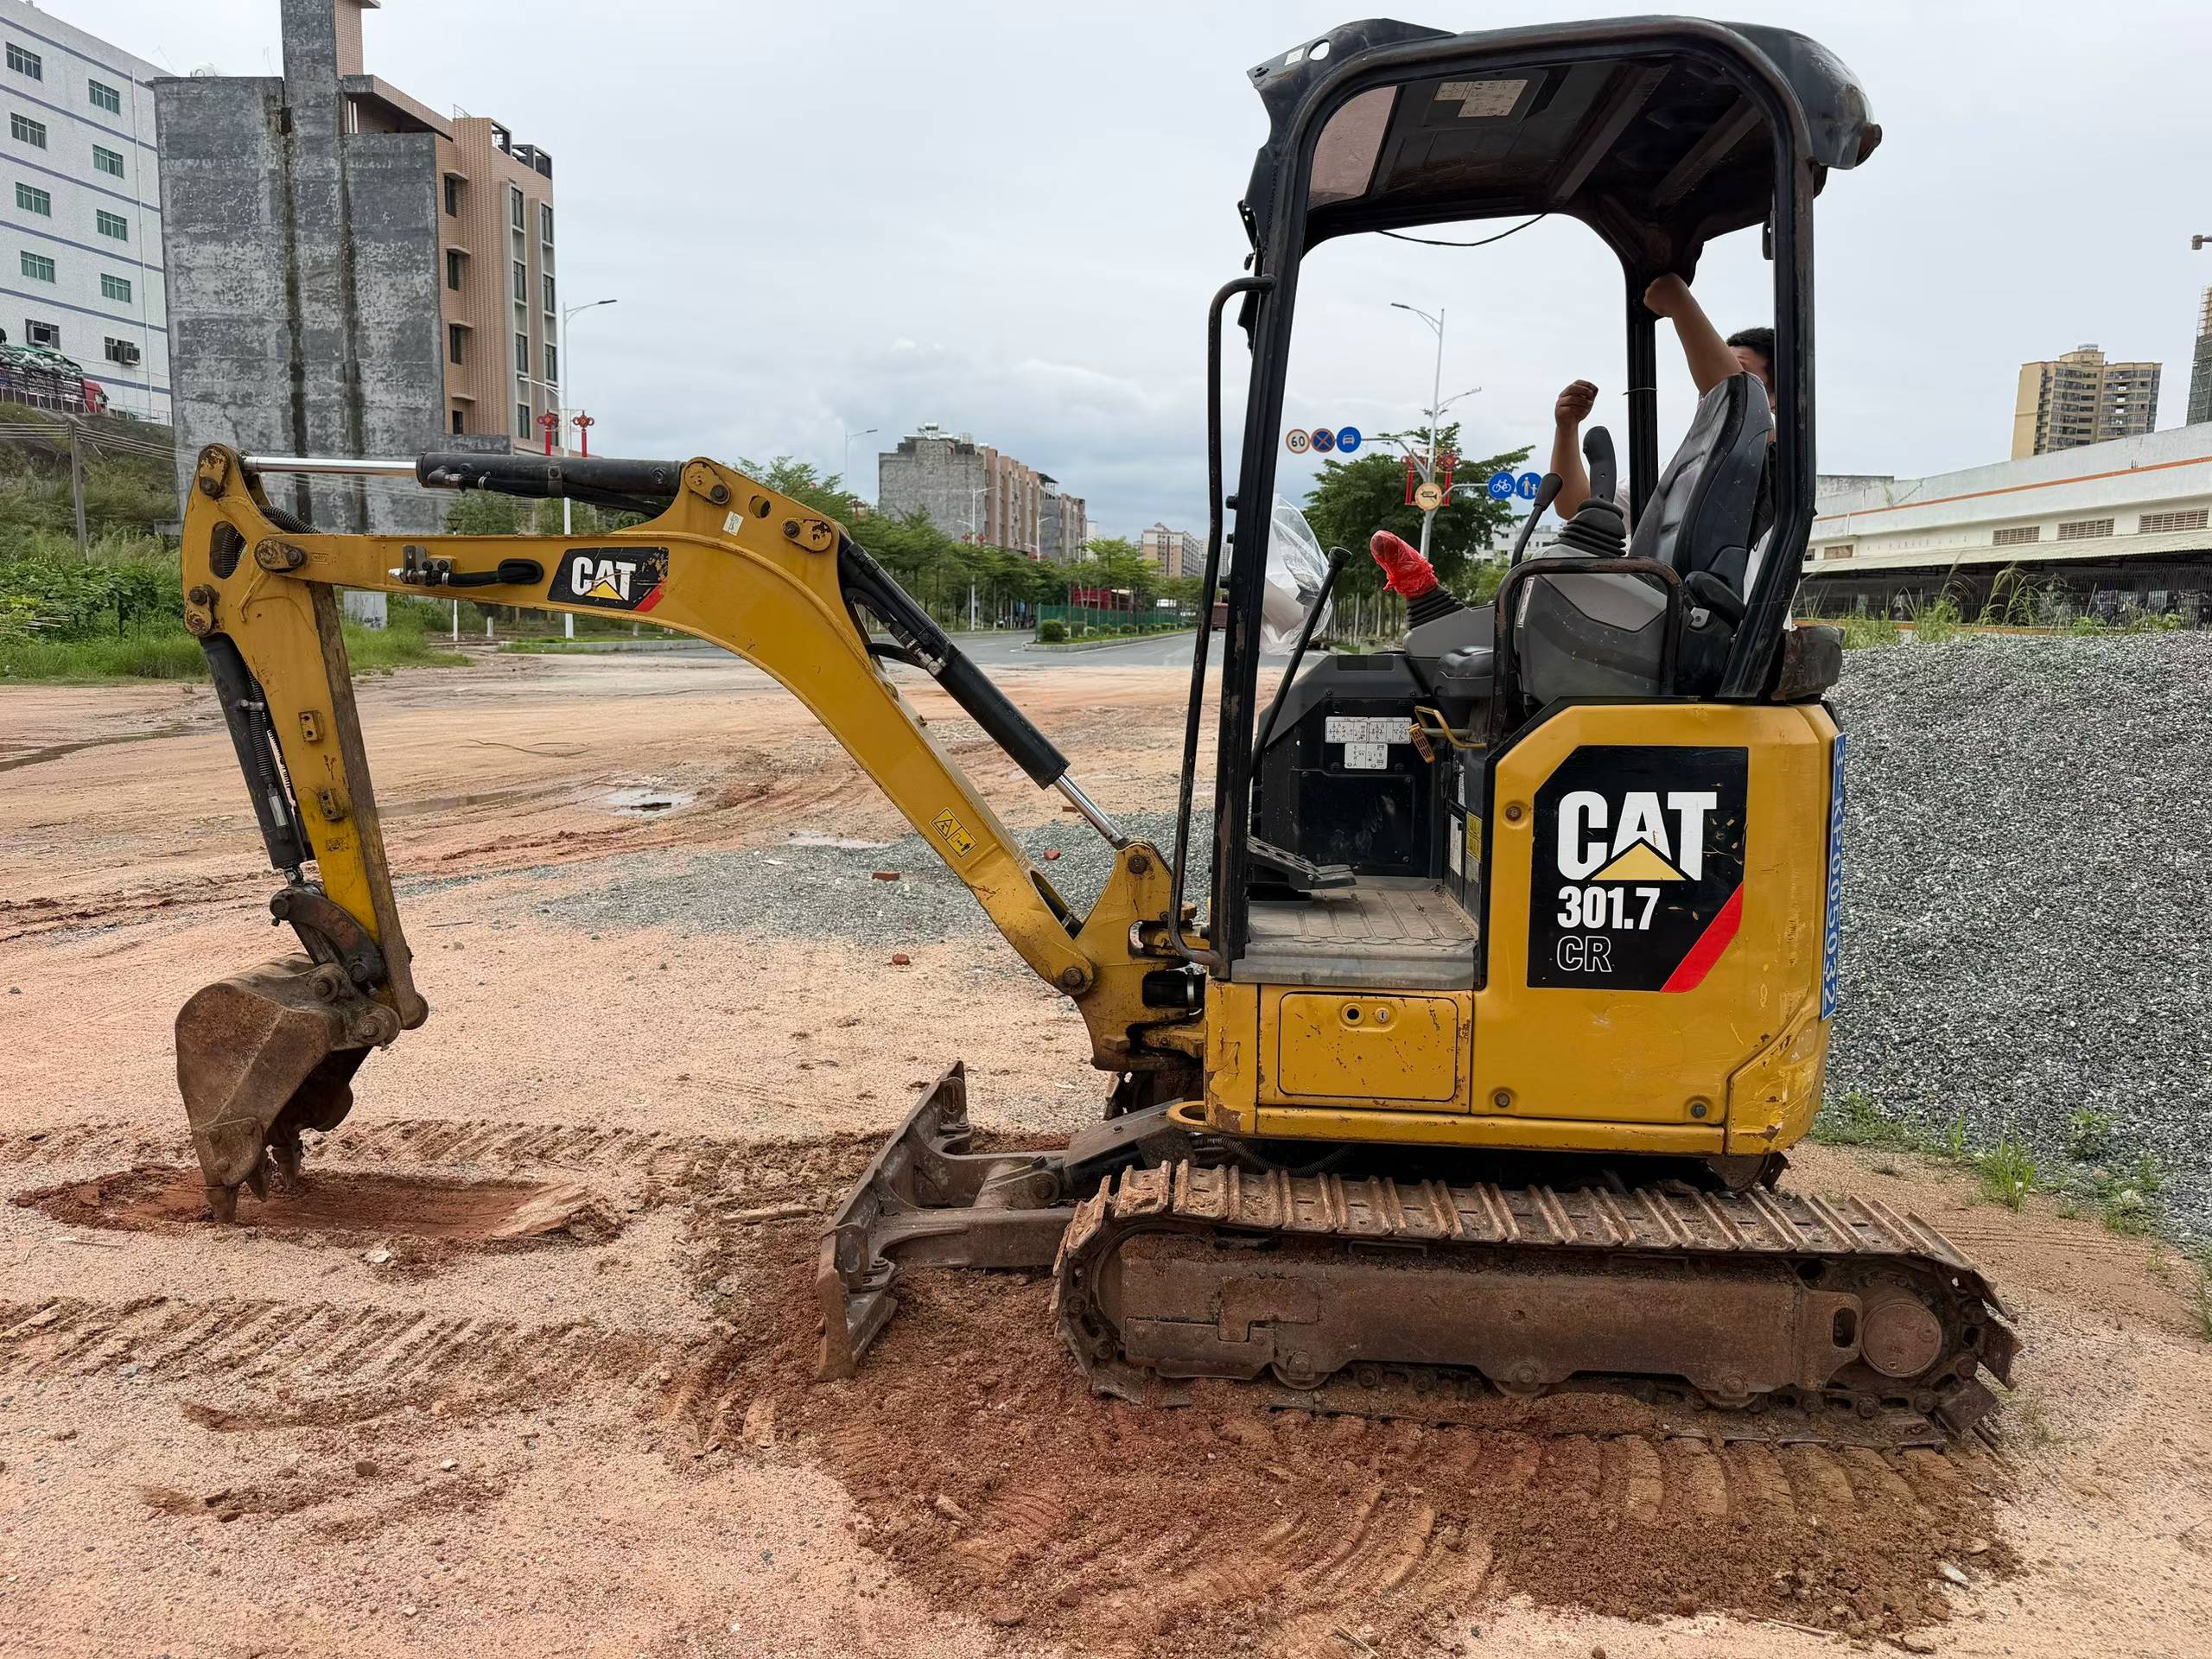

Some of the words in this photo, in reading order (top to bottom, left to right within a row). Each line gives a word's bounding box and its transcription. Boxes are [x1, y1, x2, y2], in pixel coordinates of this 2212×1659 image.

[1291, 435, 1306, 448] 60
[571, 556, 637, 601] CAT
[1557, 791, 1717, 881] CAT
[1557, 886, 1661, 931] 301.7
[1556, 936, 1612, 973] CR
